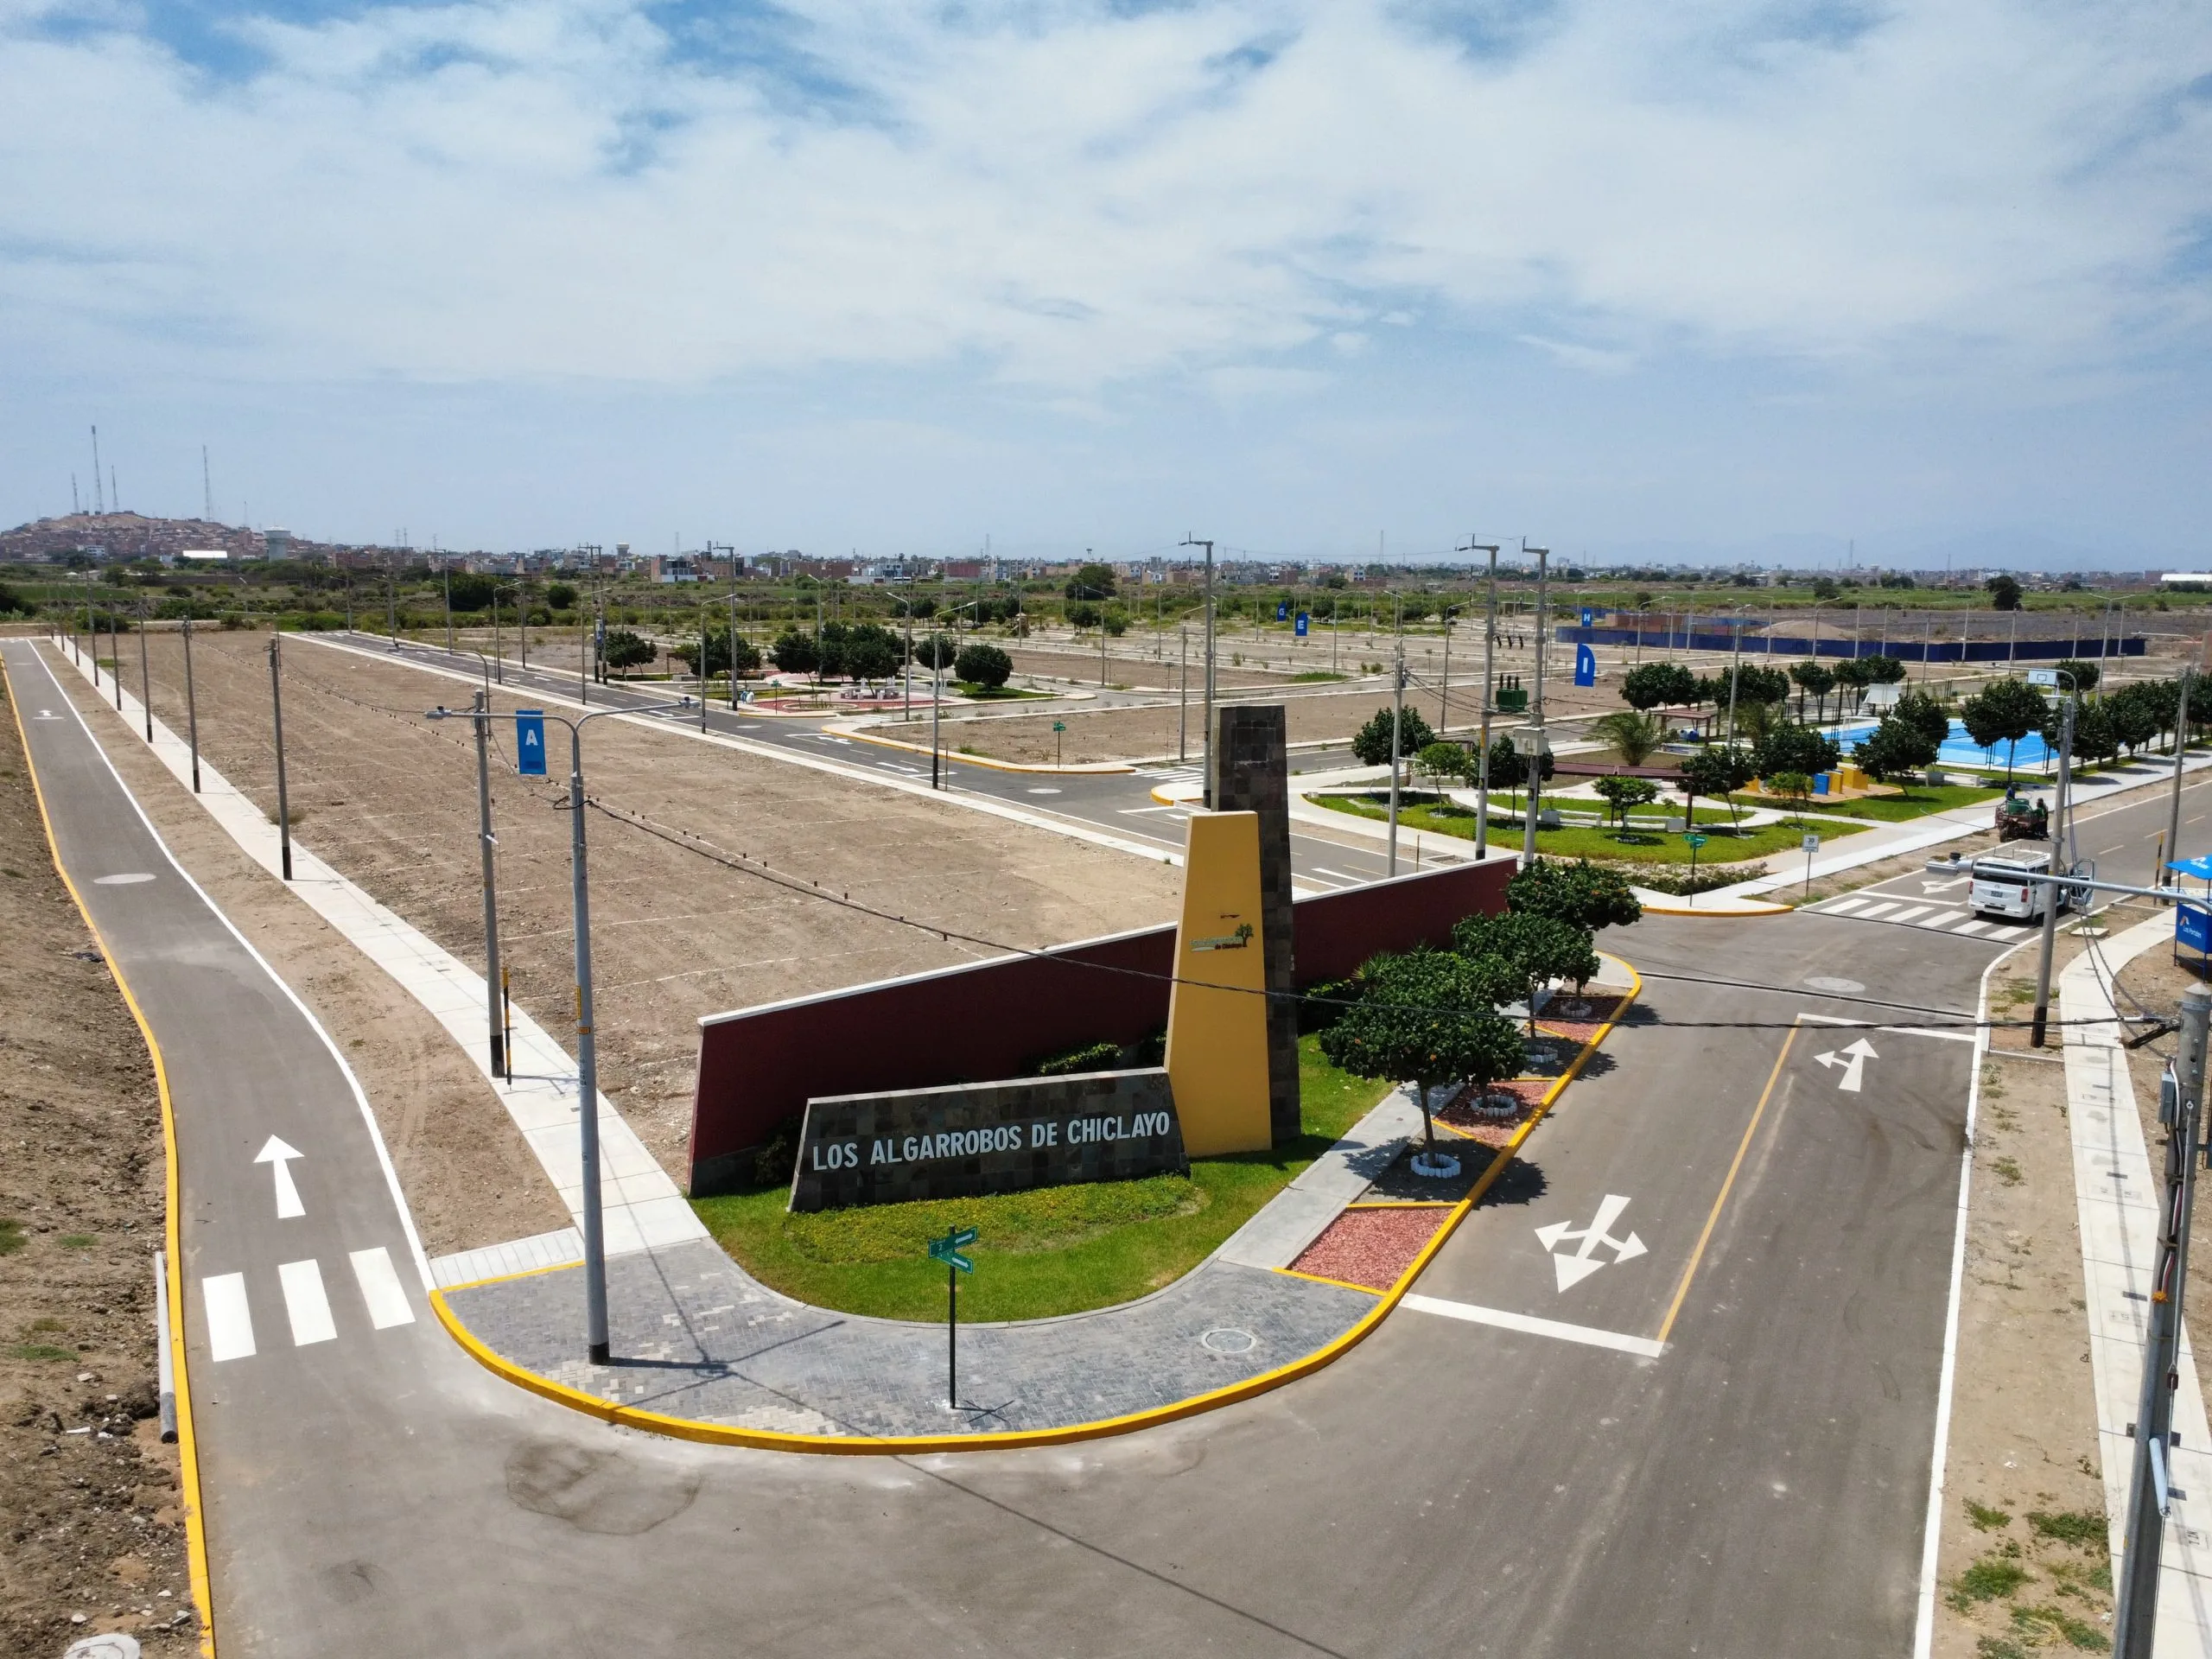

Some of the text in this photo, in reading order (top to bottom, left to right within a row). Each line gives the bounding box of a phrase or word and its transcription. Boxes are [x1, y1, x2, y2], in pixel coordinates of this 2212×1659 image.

[1584, 613, 1591, 622] H
[1298, 620, 1305, 630] E
[525, 729, 538, 747] A
[813, 1111, 1170, 1171] LOS ALGARROBOS DE CHICLAYO
